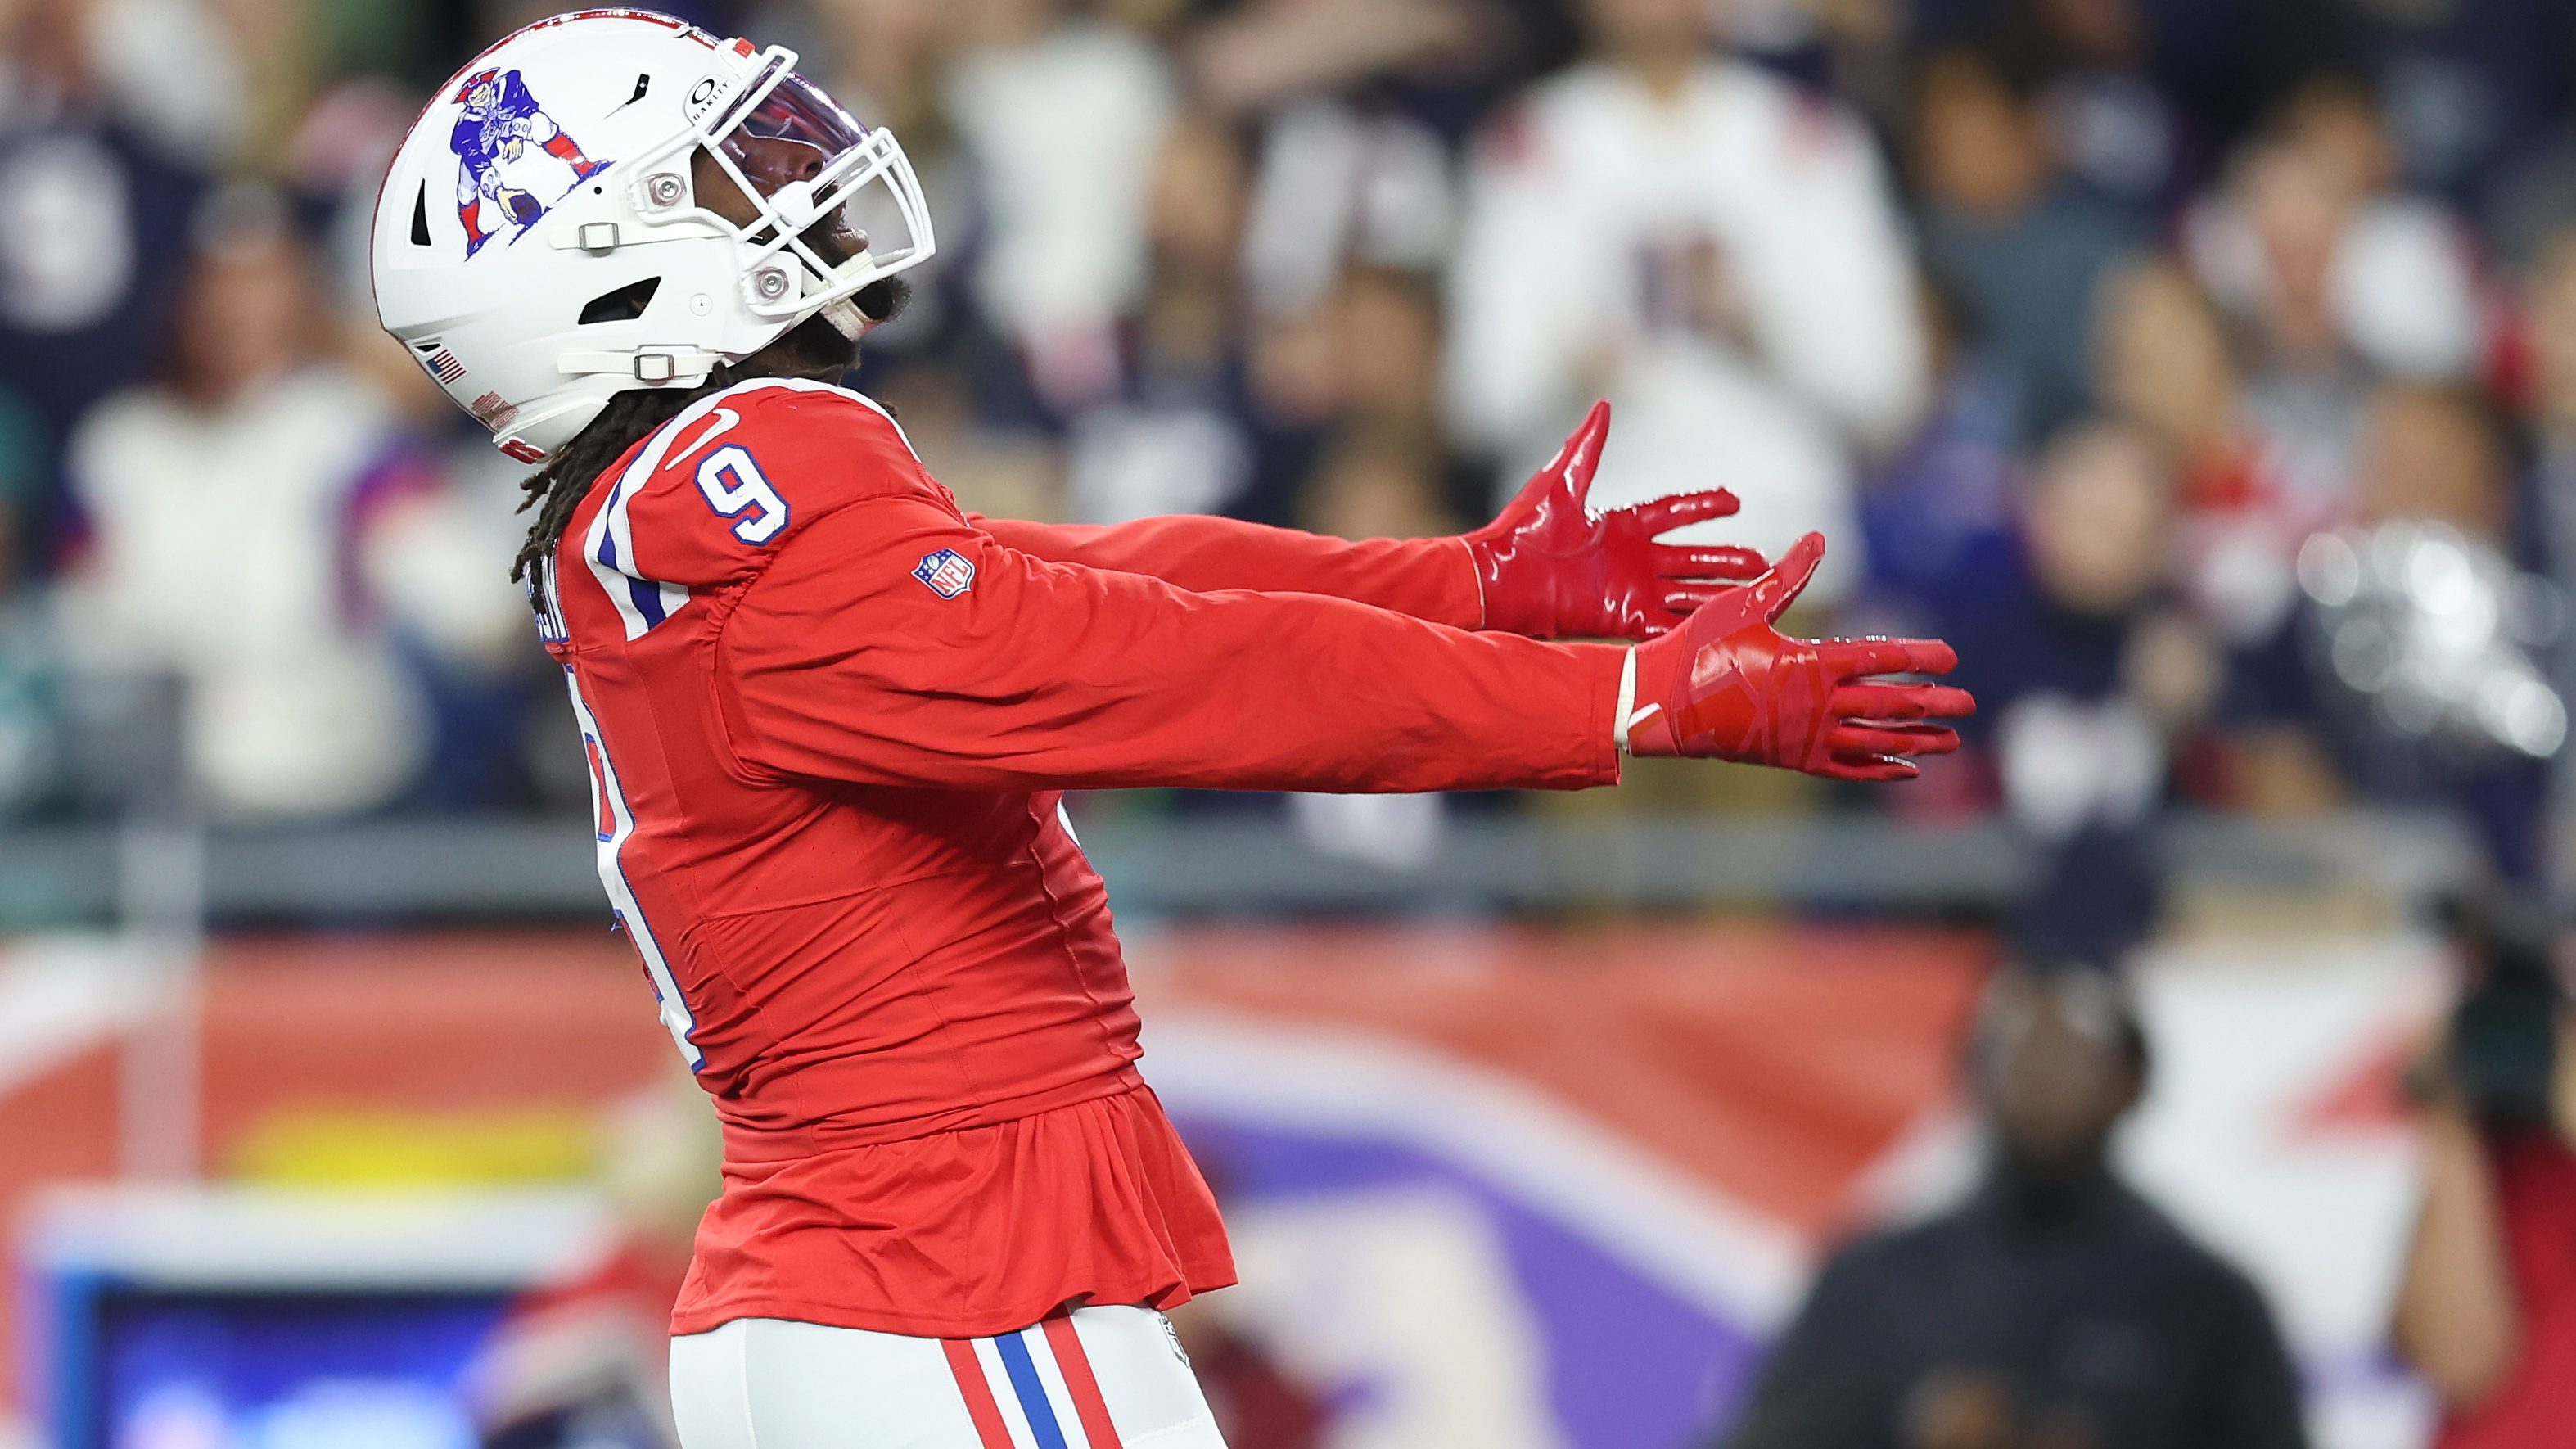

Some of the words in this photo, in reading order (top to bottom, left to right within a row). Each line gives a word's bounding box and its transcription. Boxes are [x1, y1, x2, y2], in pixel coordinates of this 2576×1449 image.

[693, 82, 729, 120] OAKLEY
[694, 442, 791, 546] 9
[932, 559, 969, 594] NFL
